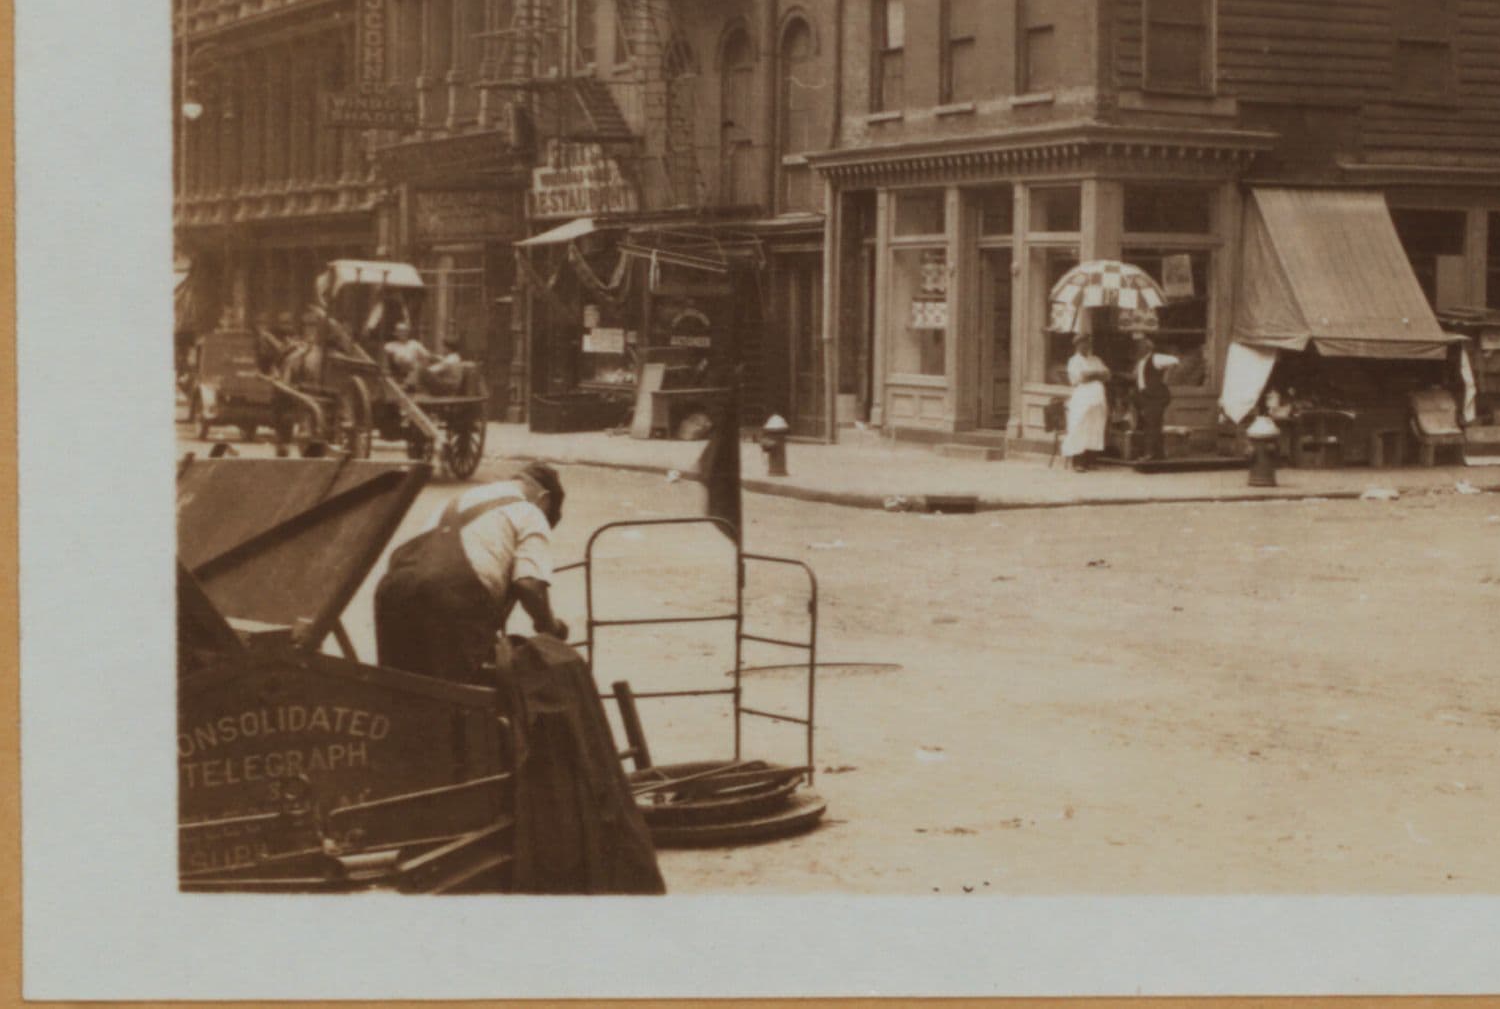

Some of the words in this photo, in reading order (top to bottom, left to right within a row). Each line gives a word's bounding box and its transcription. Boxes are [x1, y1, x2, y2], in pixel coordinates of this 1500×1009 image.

[528, 190, 638, 215] RESTAUNT
[178, 705, 392, 758] ONSOLIDATED
[181, 741, 368, 789] TELEGRAPH
